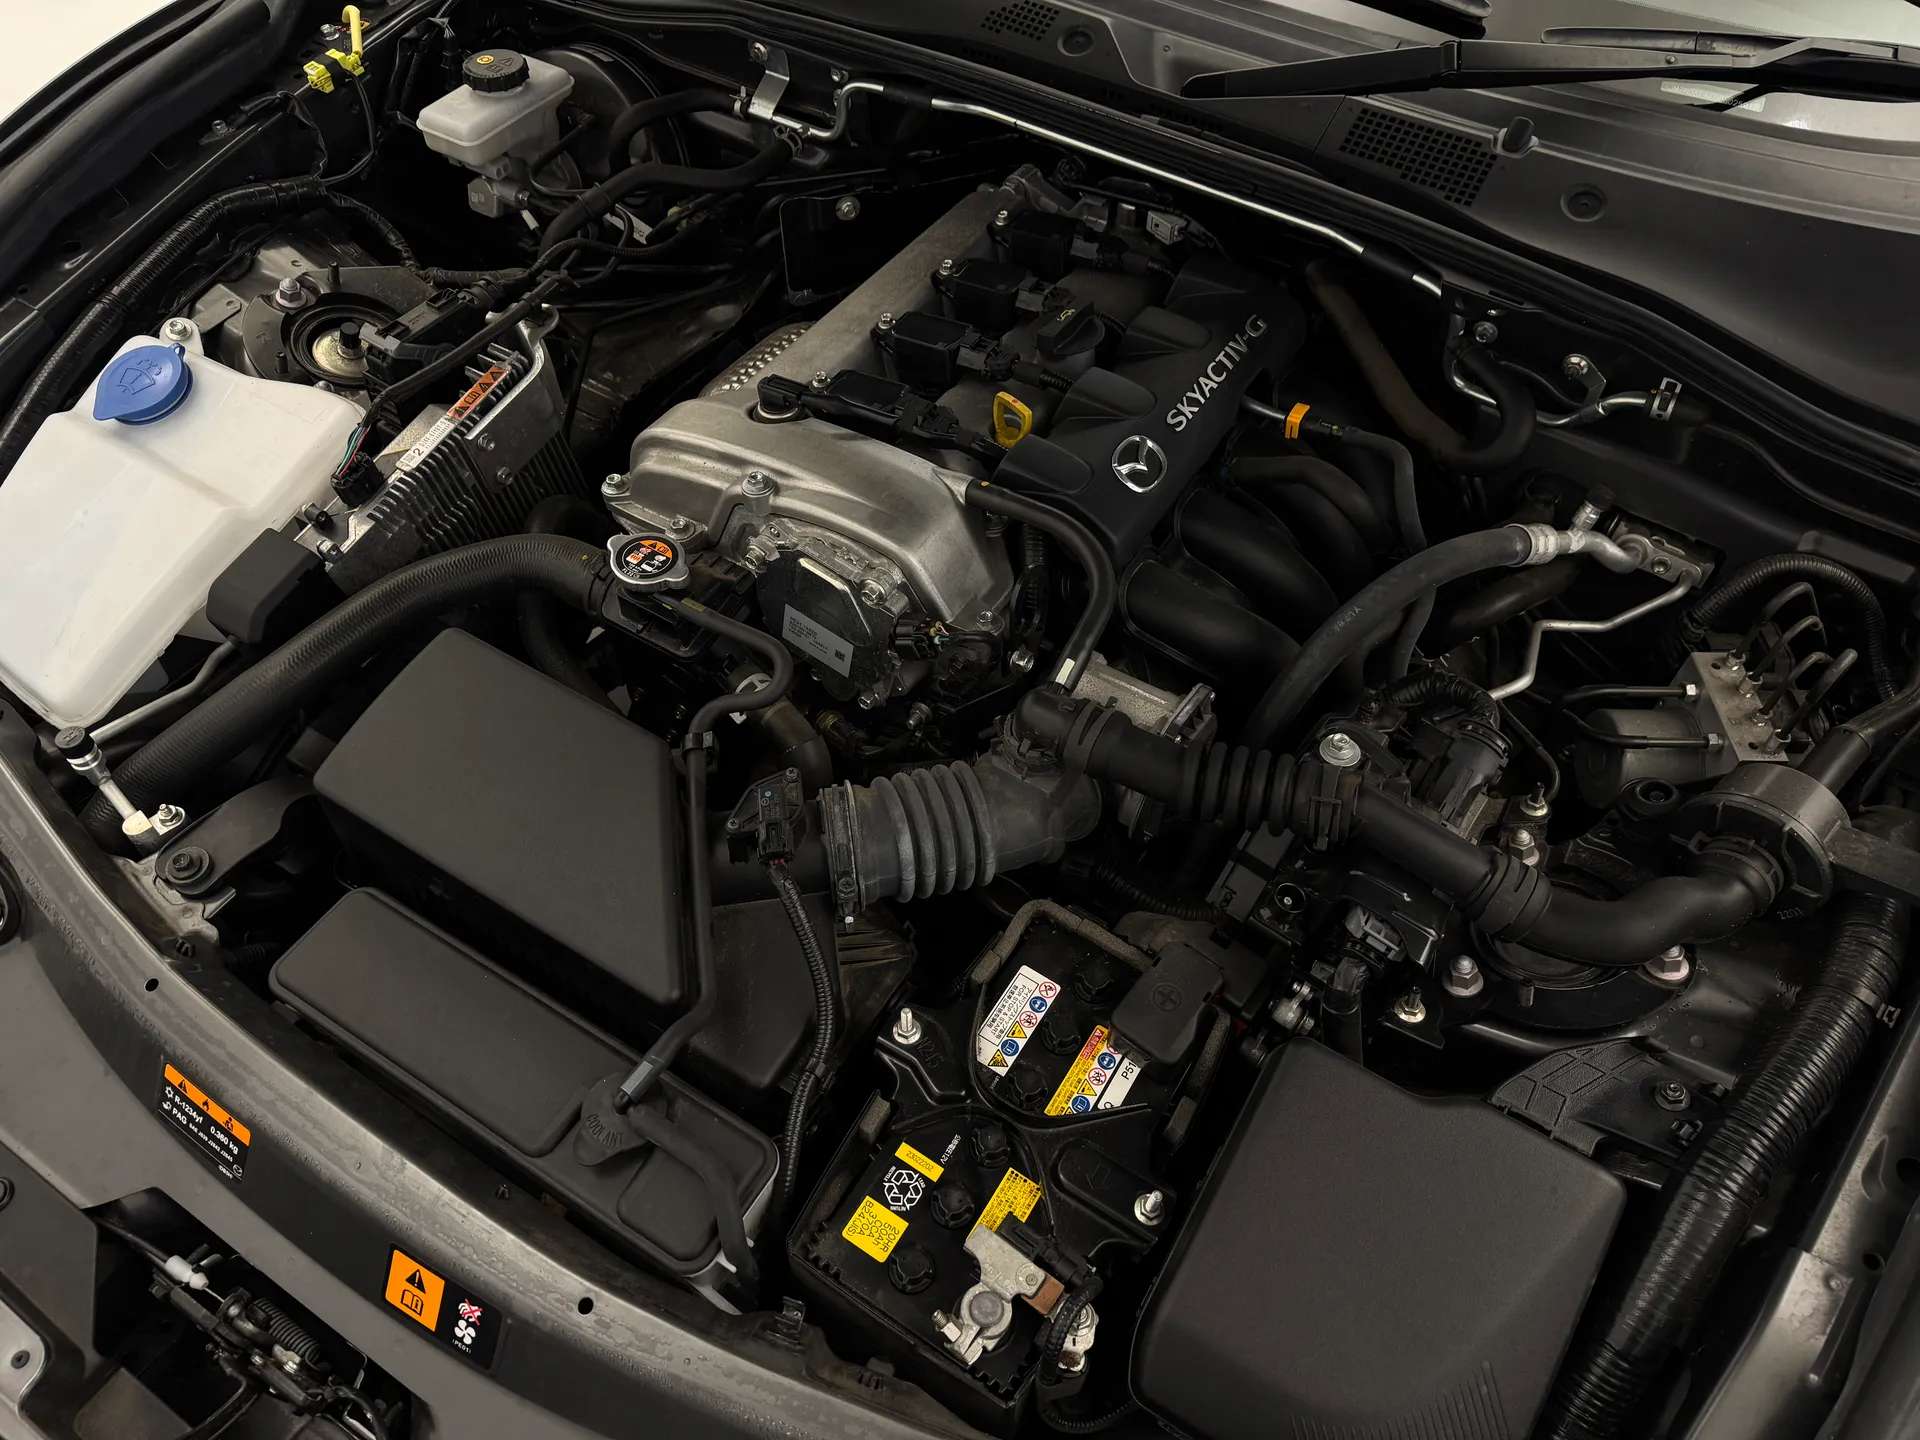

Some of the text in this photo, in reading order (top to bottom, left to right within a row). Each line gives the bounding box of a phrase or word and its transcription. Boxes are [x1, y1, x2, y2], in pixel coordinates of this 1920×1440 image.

[1166, 314, 1268, 432] SKYACTIV-G
[1014, 983, 1026, 997] FOR
[1005, 995, 1018, 1012] STOP
[989, 1015, 1005, 1035] START
[1120, 1061, 1137, 1080] P51
[172, 1107, 188, 1125] PAG
[174, 1095, 203, 1124] R-1234yf
[228, 1141, 239, 1155] kg
[855, 1210, 878, 1238] 370A
[865, 1217, 884, 1240] CCA
[871, 1221, 892, 1247] 50Ah
[878, 1225, 901, 1253] 20HR
